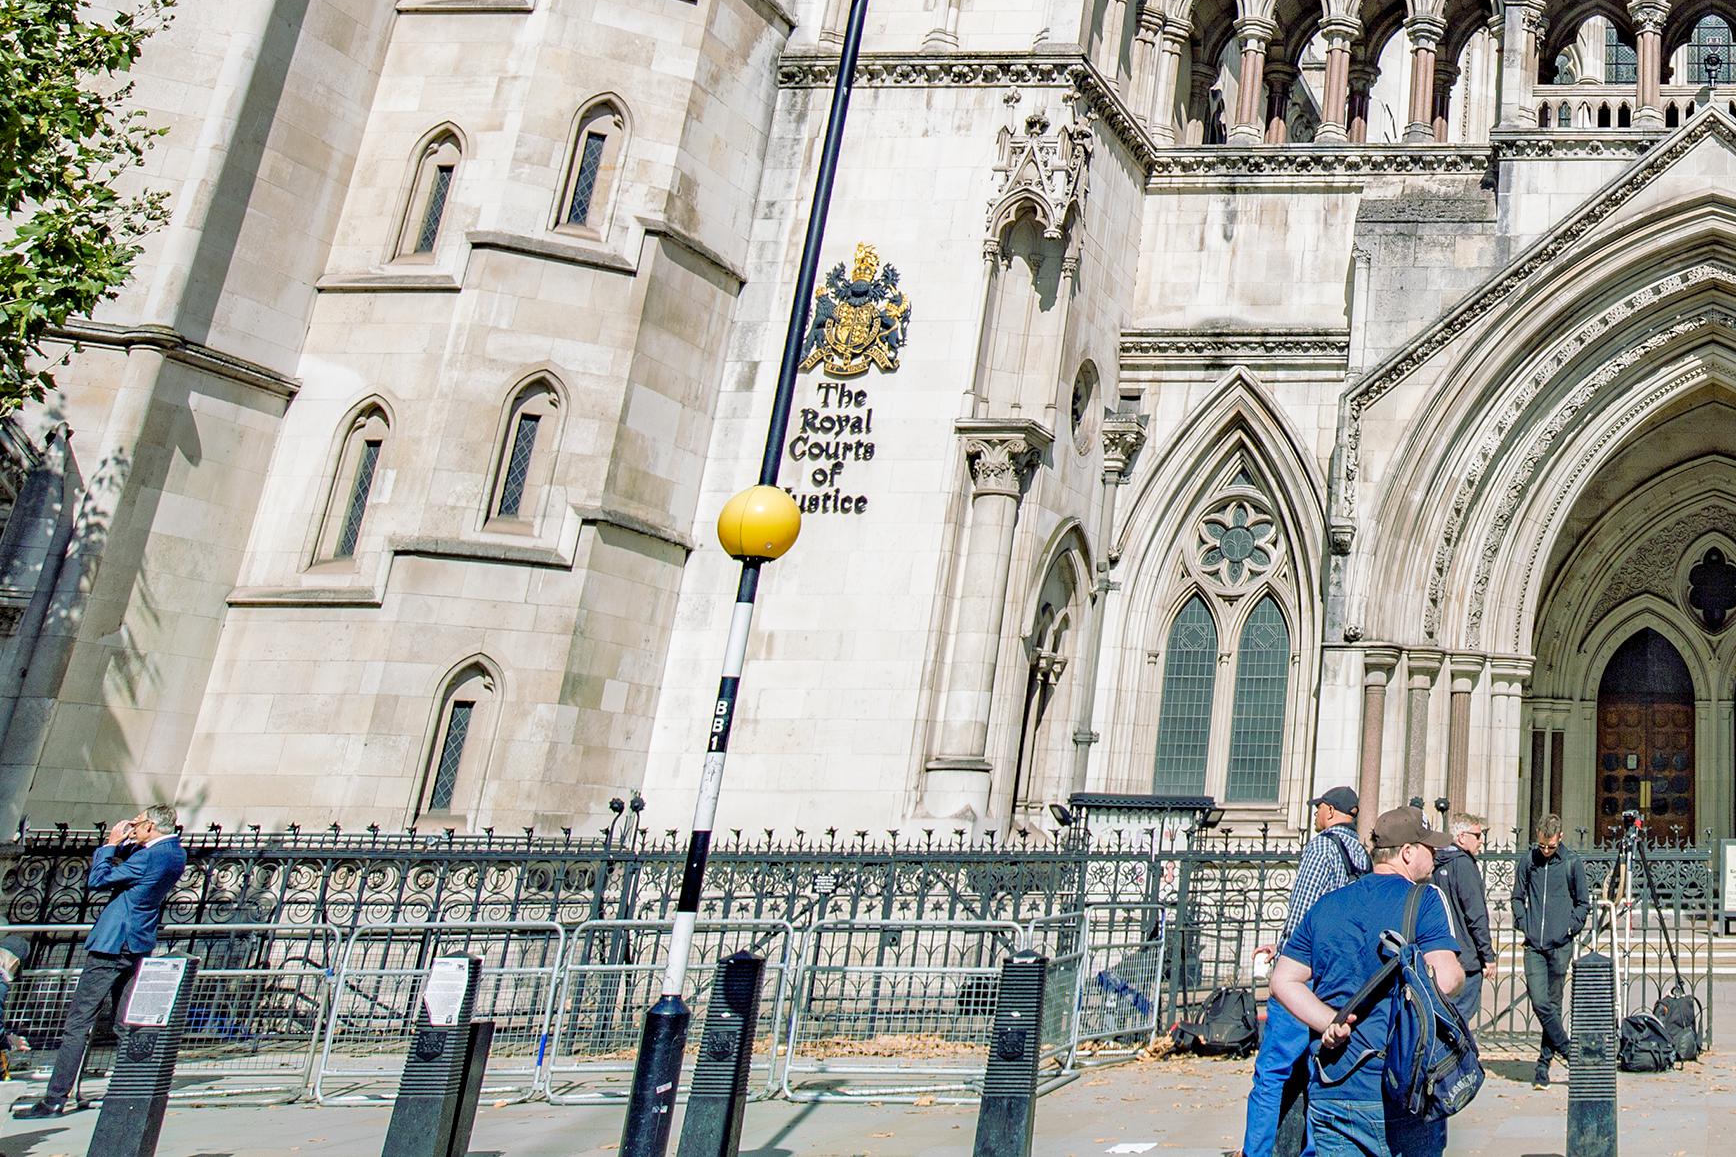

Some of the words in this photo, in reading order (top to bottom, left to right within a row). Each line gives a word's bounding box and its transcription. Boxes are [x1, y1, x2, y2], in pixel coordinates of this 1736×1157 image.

[817, 383, 867, 408] The
[800, 408, 872, 439] Royal
[789, 435, 875, 461] Courts
[811, 461, 844, 487] of
[784, 488, 868, 514] ustice
